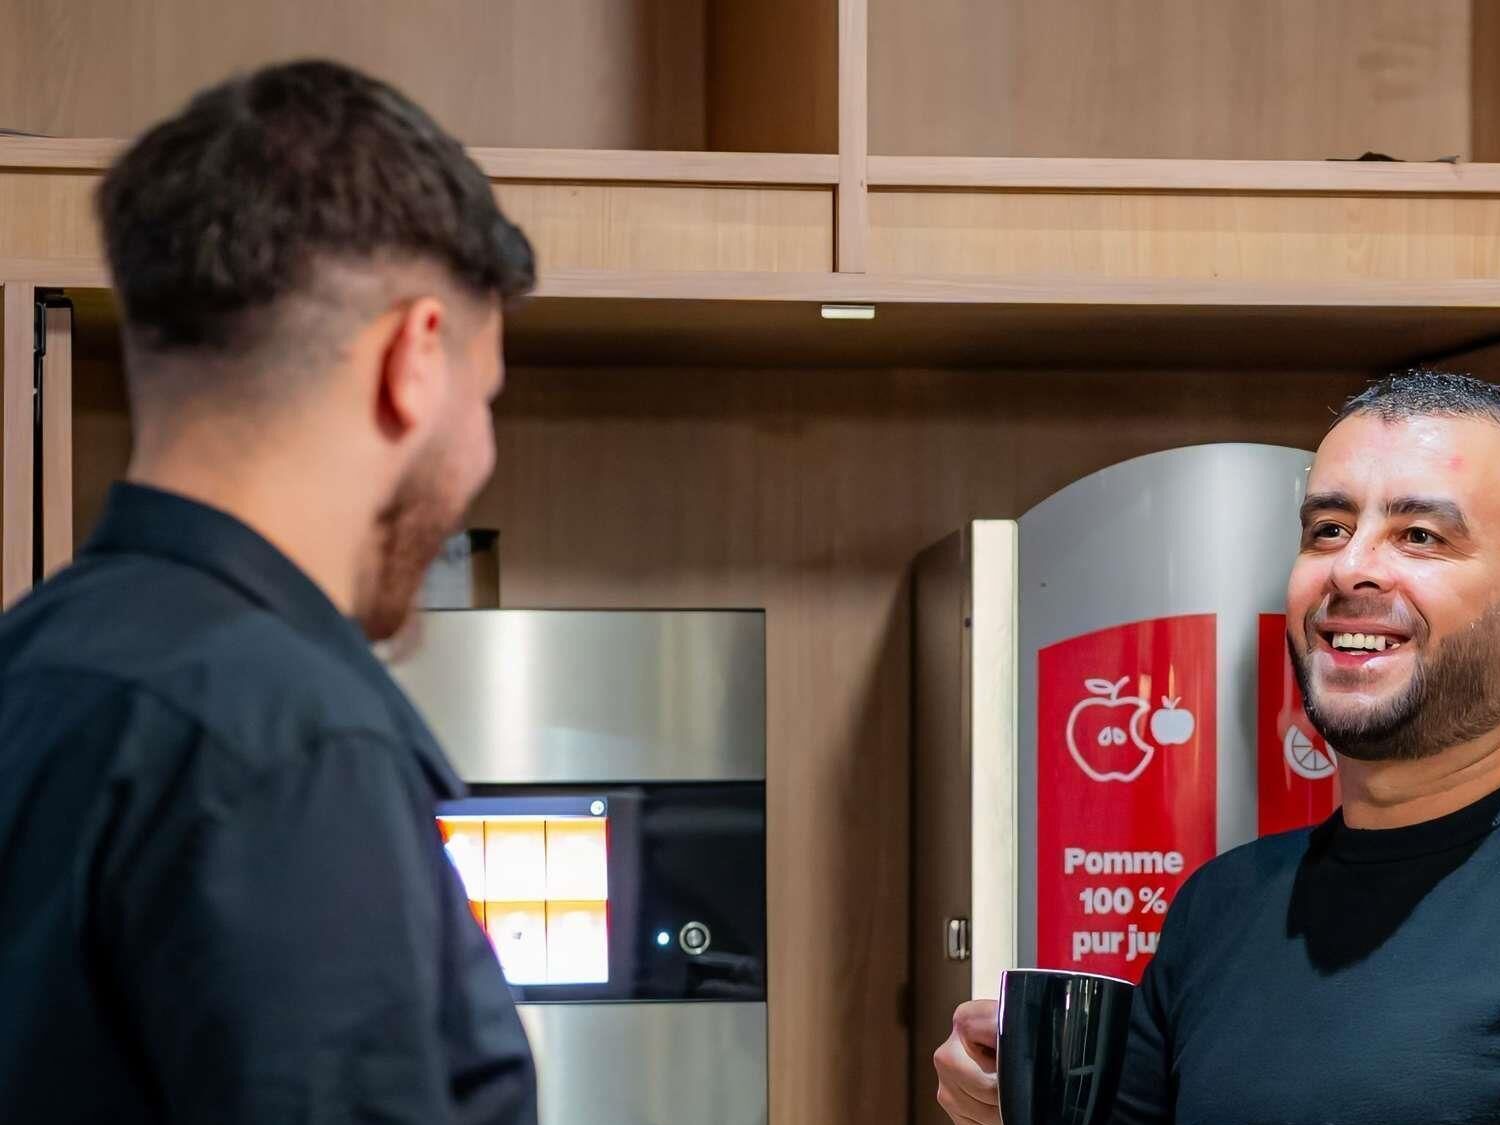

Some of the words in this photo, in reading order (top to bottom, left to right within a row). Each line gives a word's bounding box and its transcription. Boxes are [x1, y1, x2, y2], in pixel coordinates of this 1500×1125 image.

[1064, 847, 1184, 875] Pomme
[1079, 886, 1134, 915] 100
[1138, 886, 1168, 915] %
[1072, 931, 1125, 962] pur
[1125, 923, 1161, 962] ju
